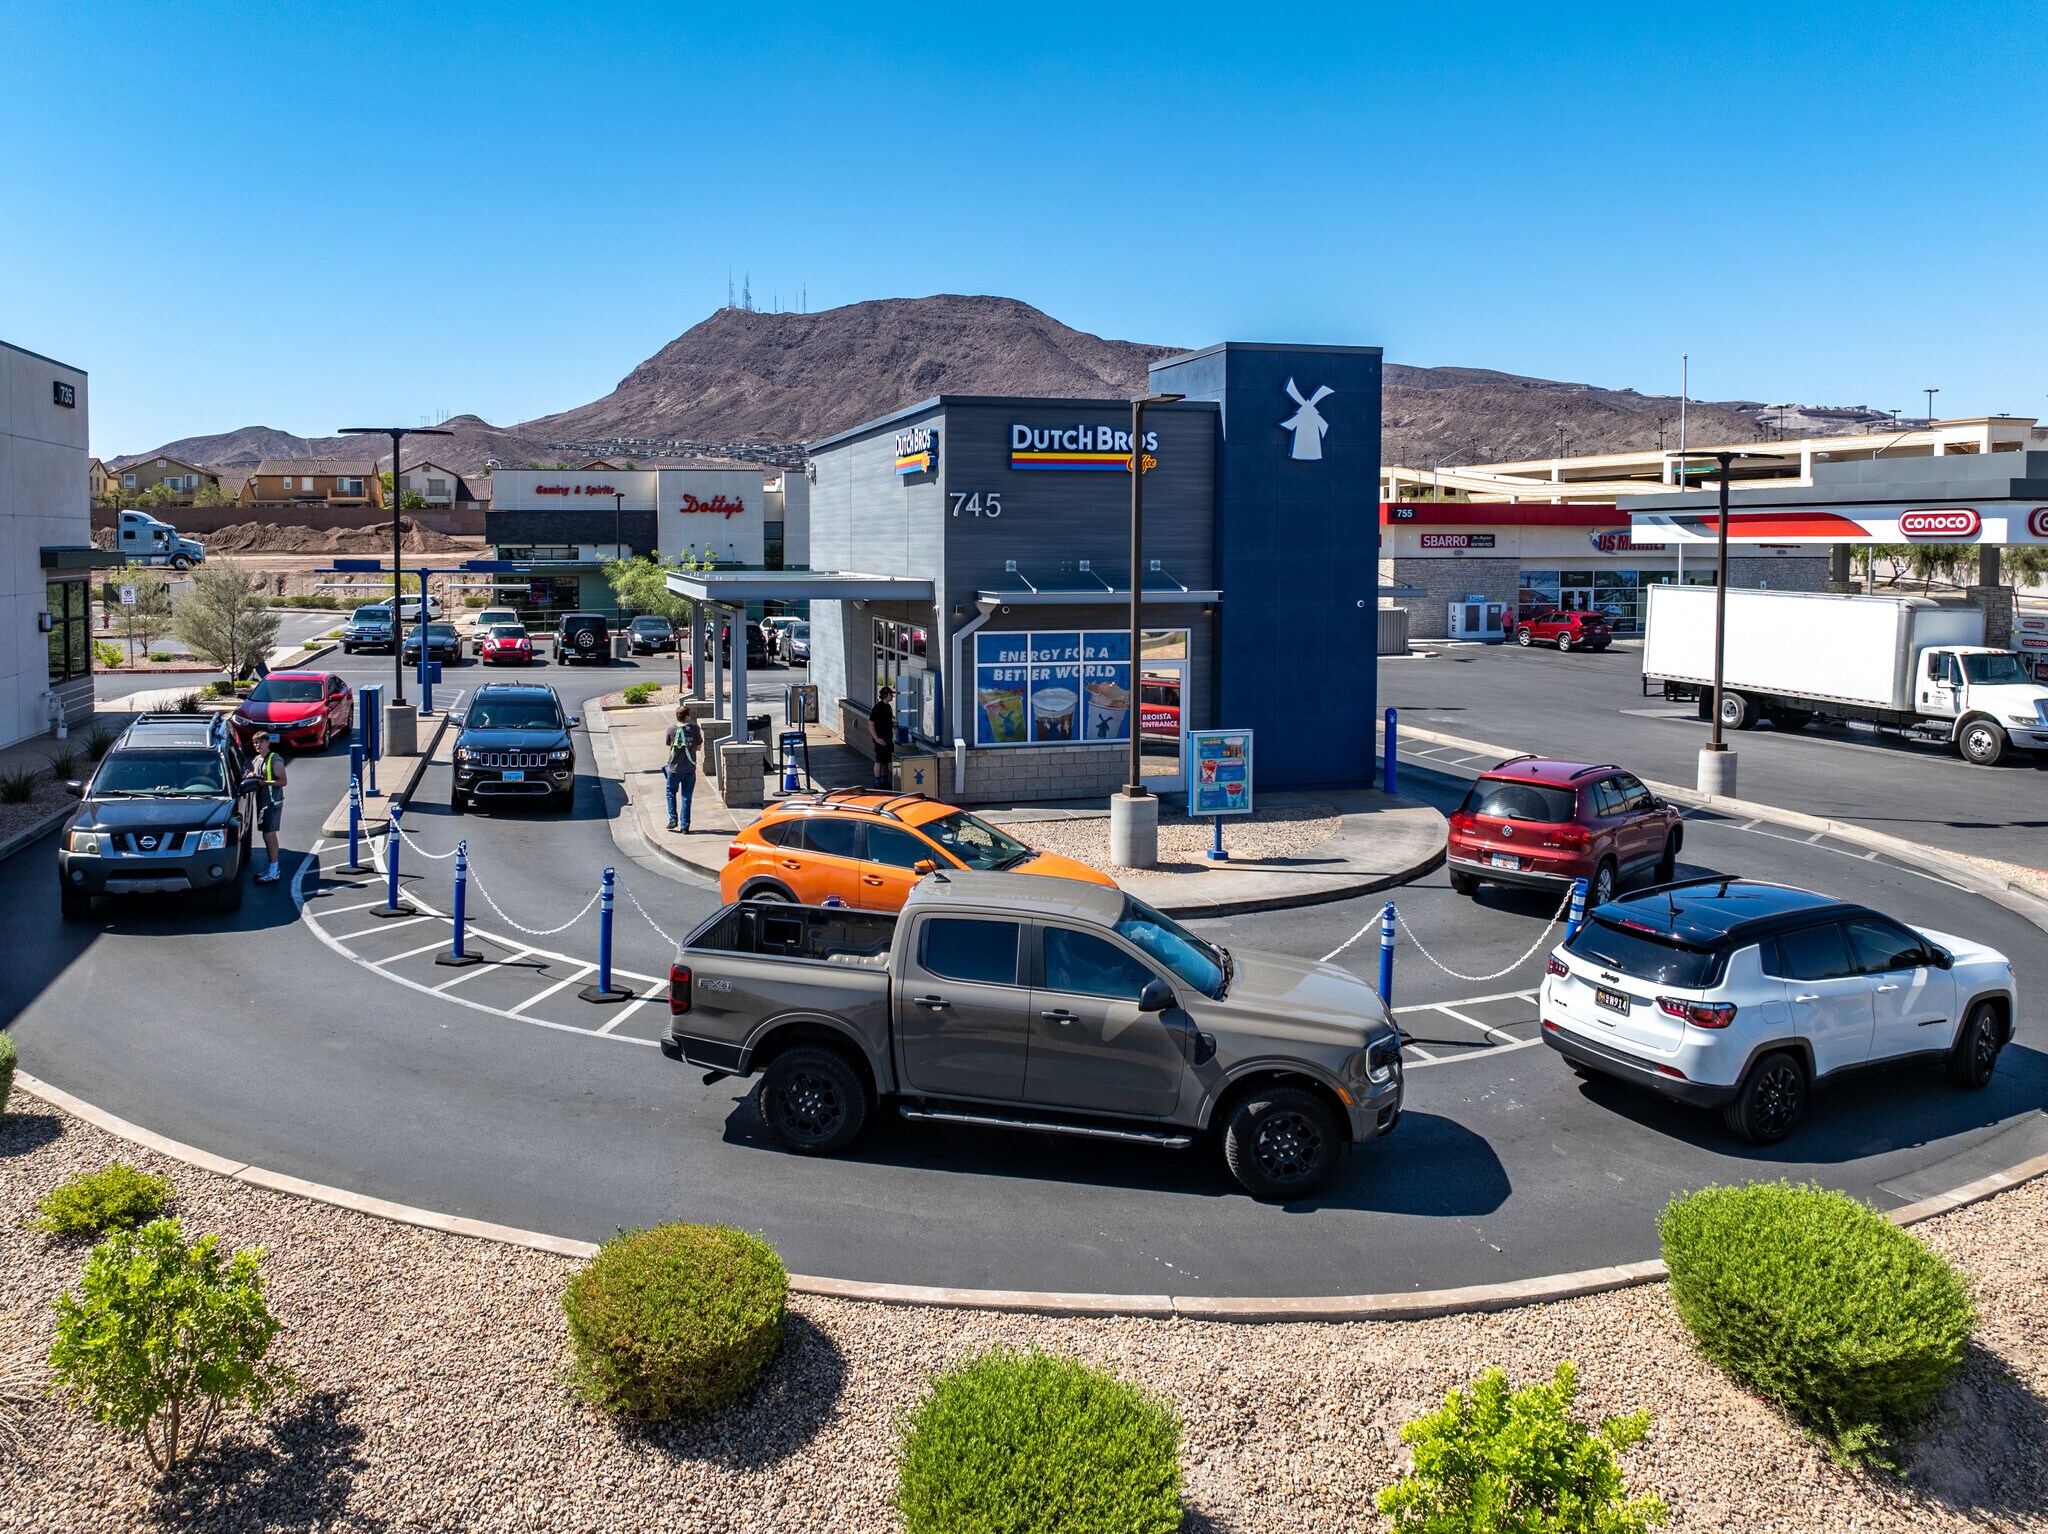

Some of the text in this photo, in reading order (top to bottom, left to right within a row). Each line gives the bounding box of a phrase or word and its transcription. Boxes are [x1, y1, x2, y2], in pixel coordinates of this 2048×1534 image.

[60, 385, 73, 405] 735
[895, 428, 931, 457] DUTCH BROS
[1012, 424, 1093, 451] DUTCH
[536, 485, 615, 496] Gaming & Spirits
[680, 493, 744, 519] Dotty's
[950, 492, 1002, 518] 745
[1396, 509, 1413, 518] 755
[1423, 535, 1468, 547] SBARRO
[1598, 534, 1616, 551] US
[999, 647, 1109, 662] ENERGY FOR A
[993, 665, 1116, 682] BETTER WORLD
[1142, 713, 1172, 721] BROISTA
[1142, 720, 1178, 728] ENTRANCE
[698, 978, 732, 992] FX4
[1600, 971, 1620, 984] Jeep
